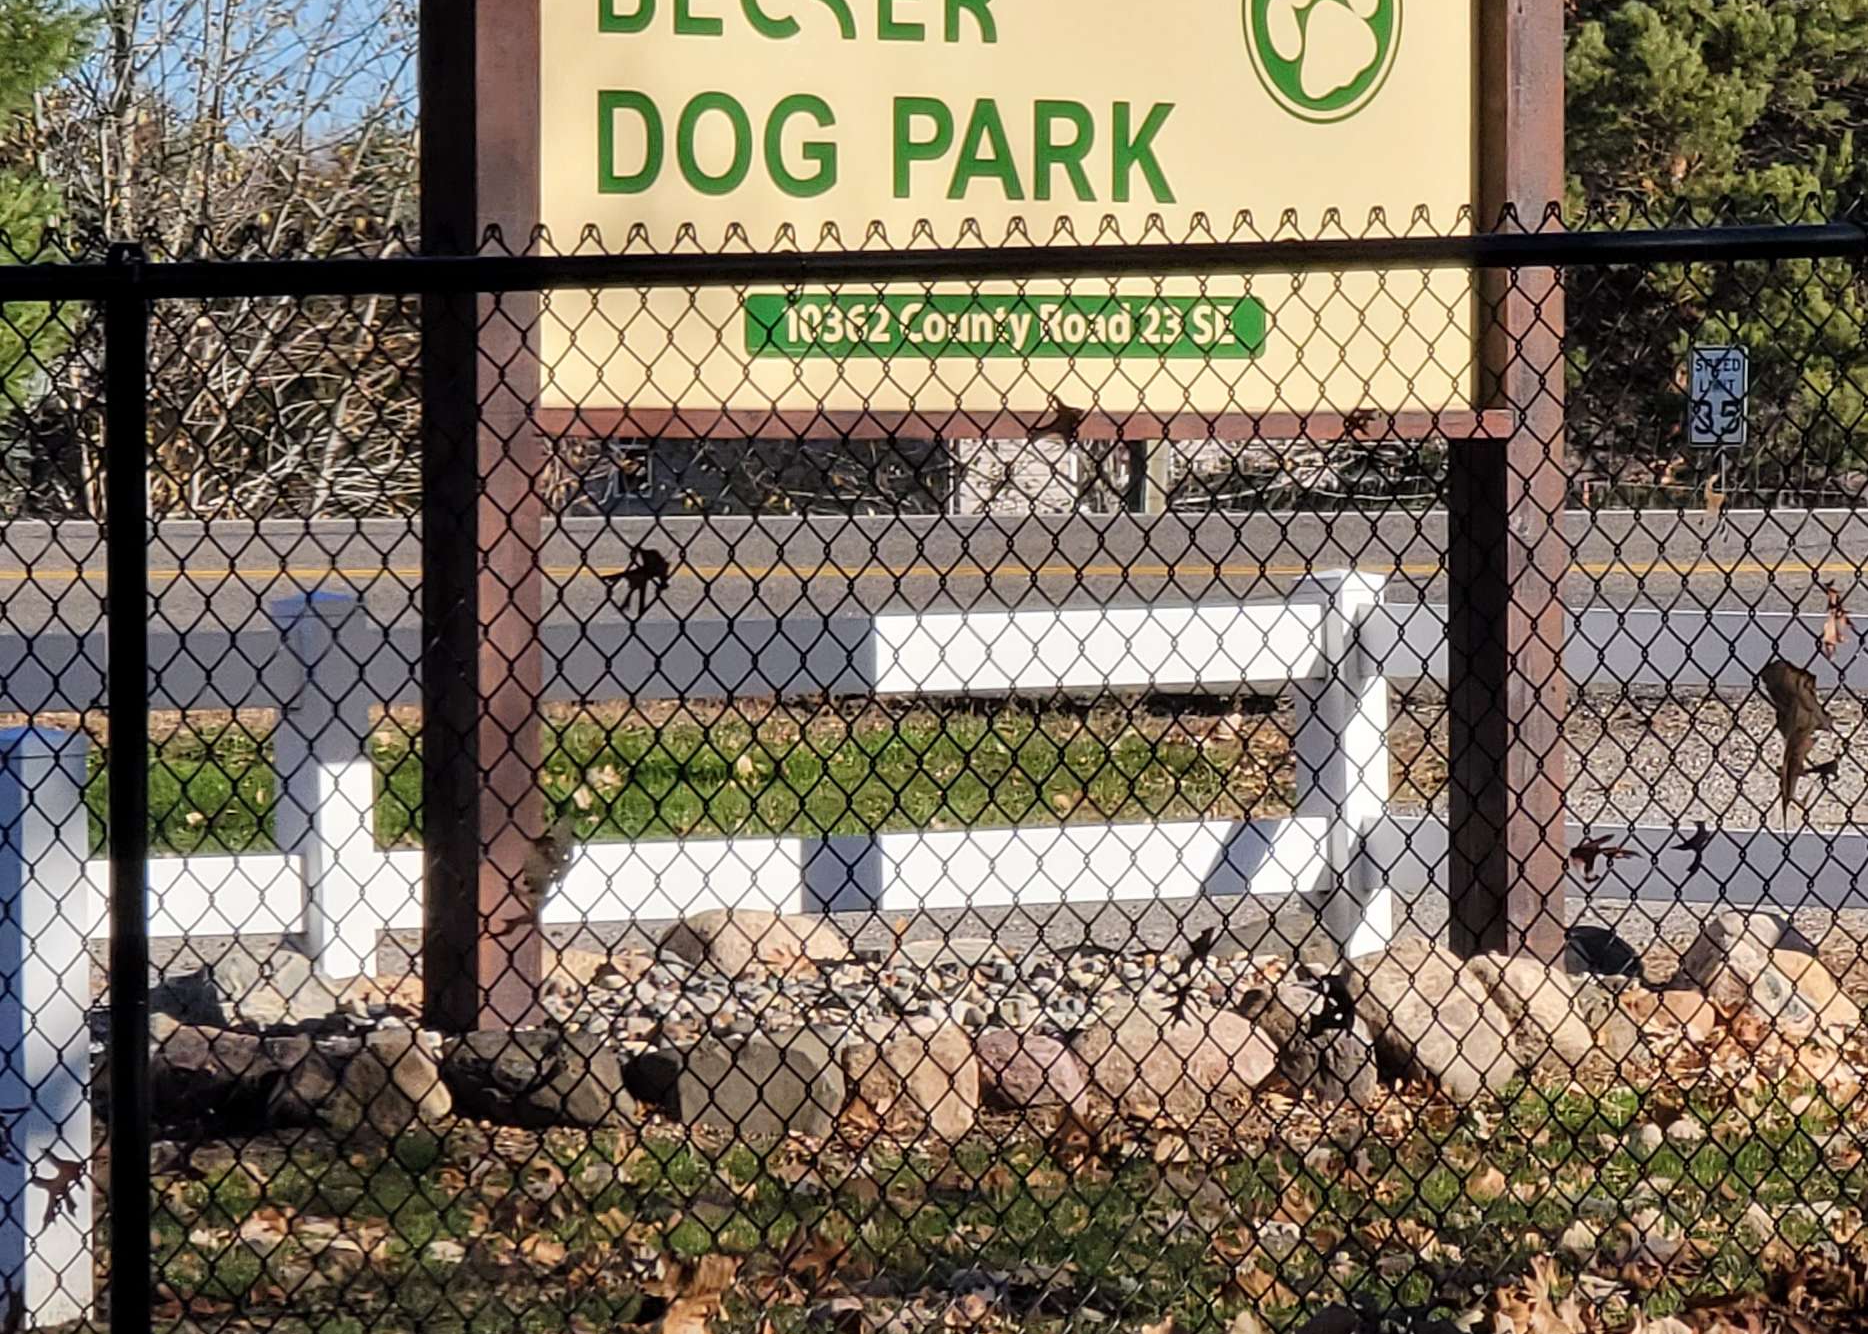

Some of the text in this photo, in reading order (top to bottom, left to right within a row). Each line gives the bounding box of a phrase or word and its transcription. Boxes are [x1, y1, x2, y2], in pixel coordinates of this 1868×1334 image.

[598, 89, 1177, 203] DOG PARK
[782, 302, 1235, 353] 10362 County Road 23 SE
[1694, 400, 1740, 435] 35
